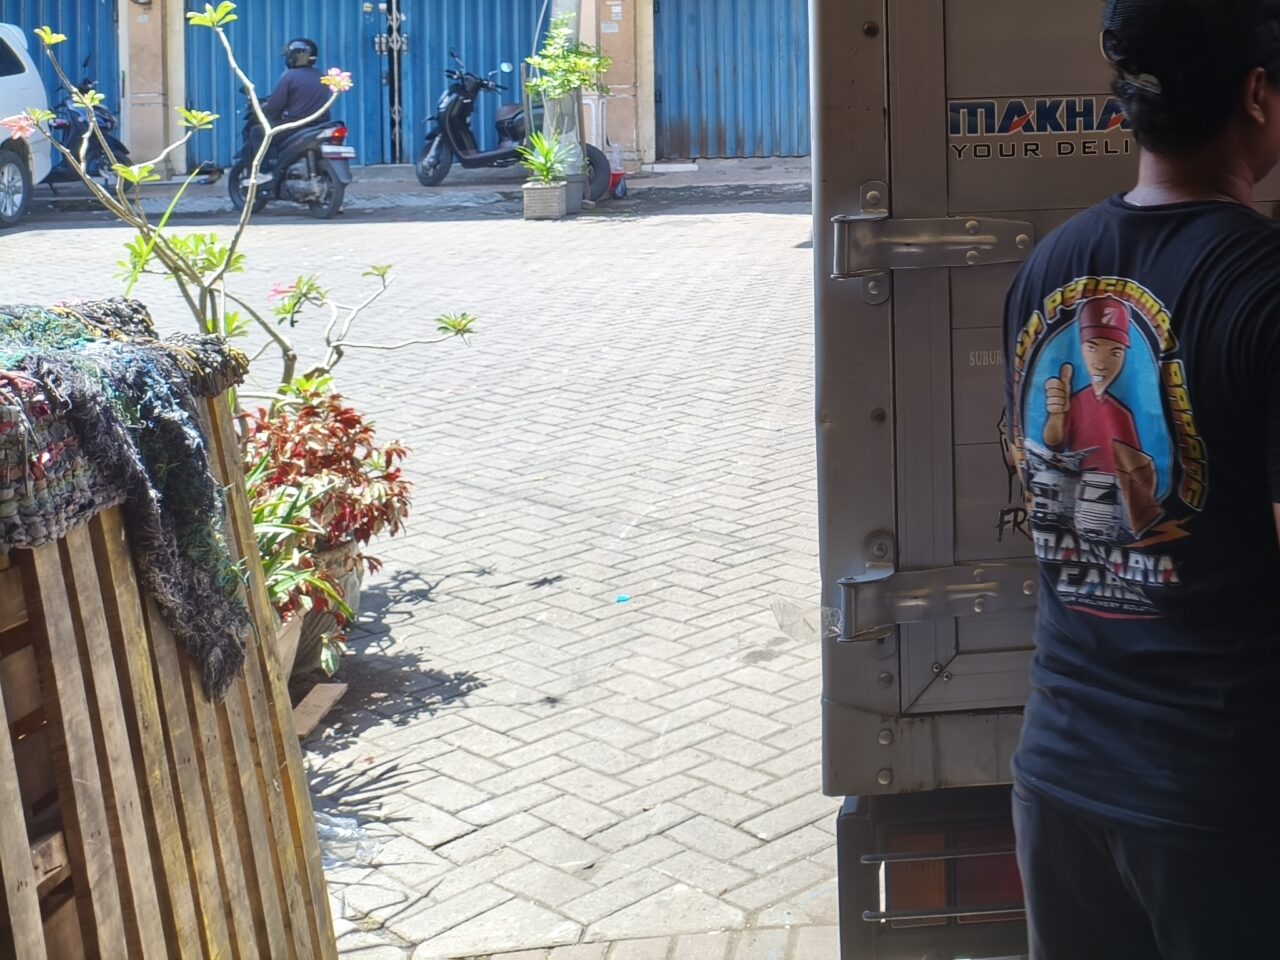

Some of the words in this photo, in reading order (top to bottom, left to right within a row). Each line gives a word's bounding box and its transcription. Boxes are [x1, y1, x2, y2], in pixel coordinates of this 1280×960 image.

[948, 96, 1134, 137] MAKHA
[951, 140, 1041, 161] YOUR
[1056, 137, 1130, 158] DELI
[995, 507, 1034, 543] FR
